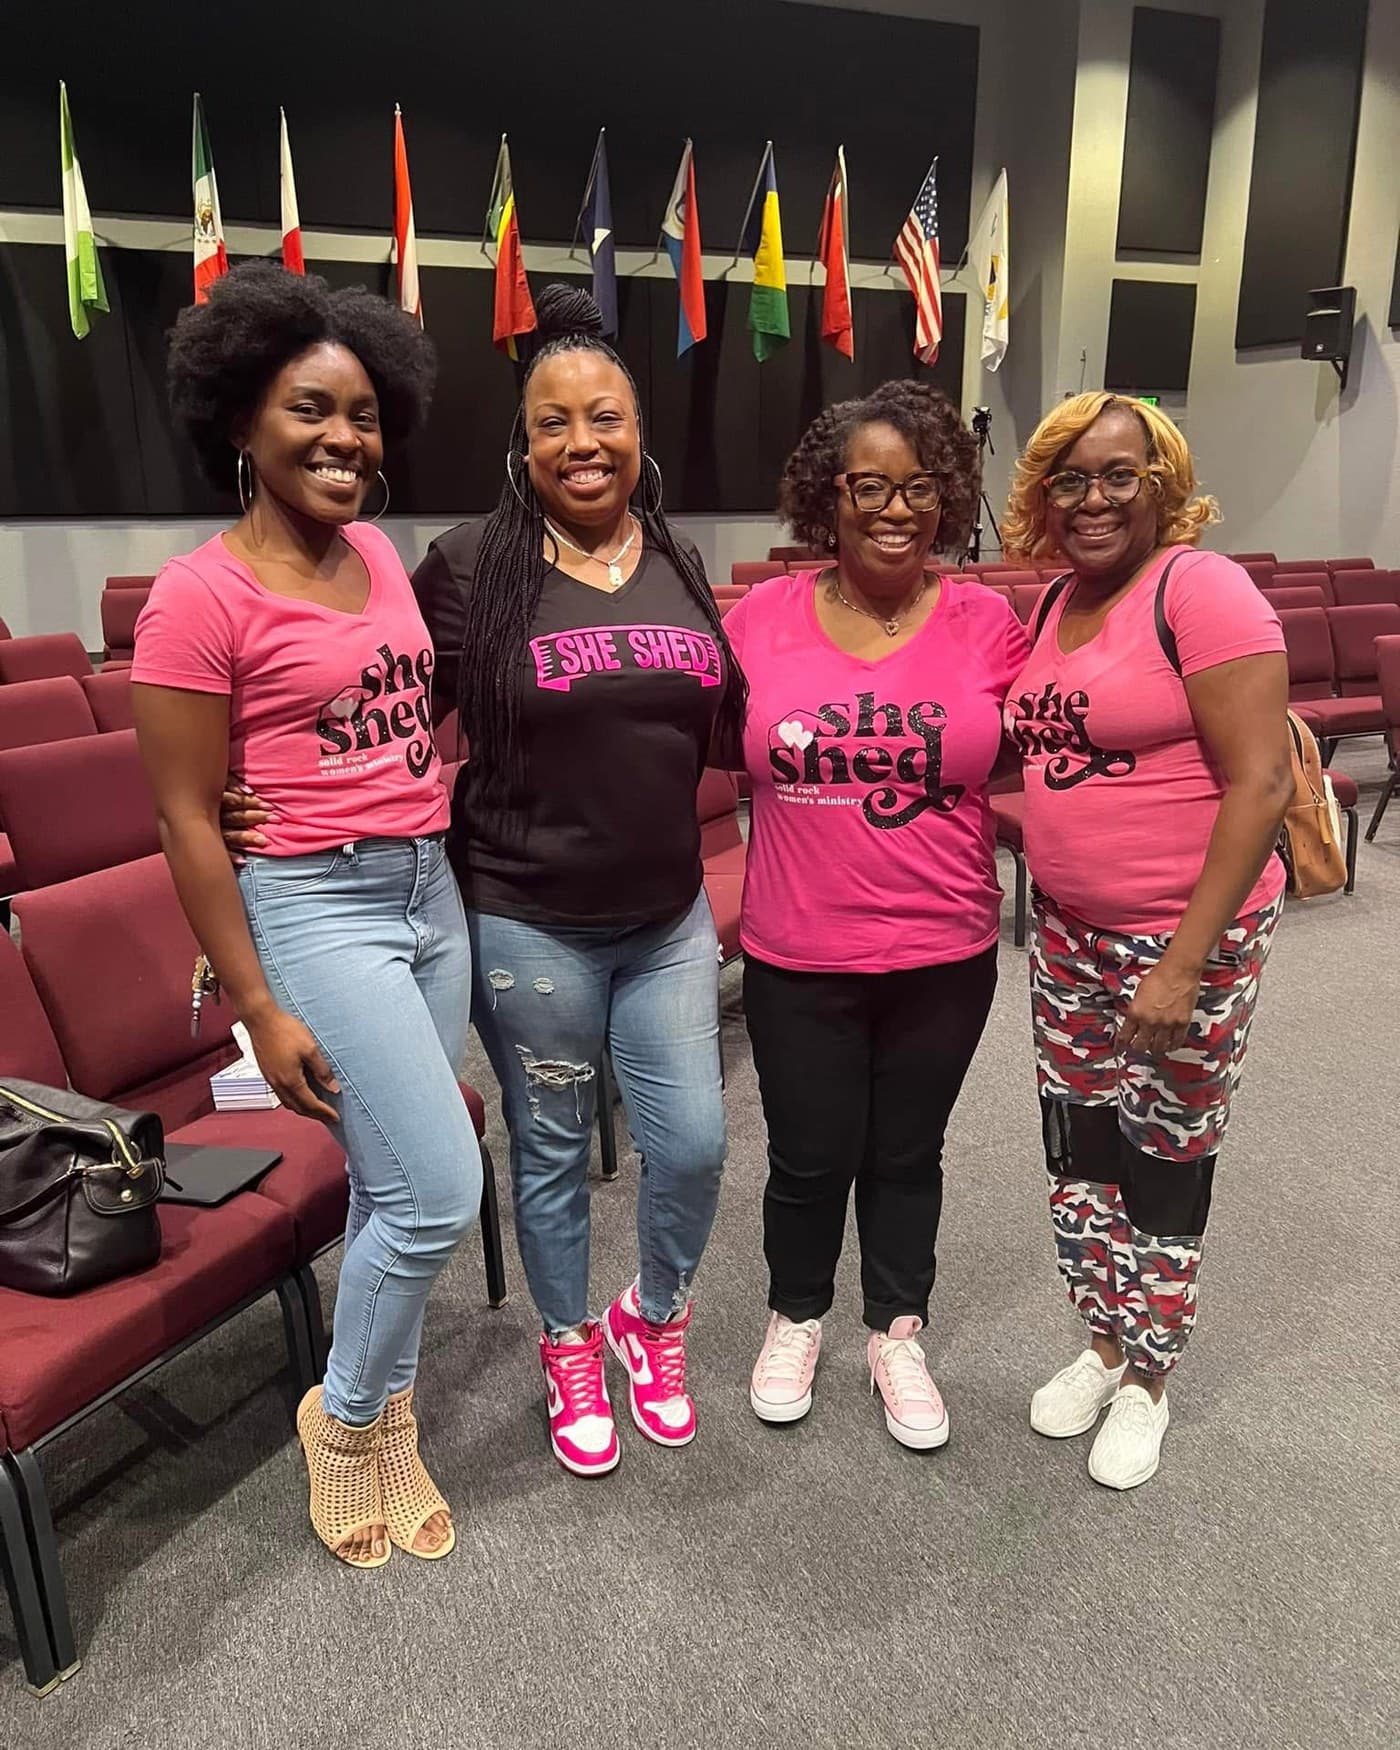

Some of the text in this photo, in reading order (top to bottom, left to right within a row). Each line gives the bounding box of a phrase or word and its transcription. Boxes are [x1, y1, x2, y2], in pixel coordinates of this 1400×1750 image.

[361, 643, 434, 703] she
[555, 630, 710, 674] SHE SHED
[813, 691, 948, 738] she
[1015, 681, 1090, 722] she
[316, 692, 438, 779] shed
[1012, 716, 1136, 791] hed
[768, 733, 967, 830] shed
[797, 785, 820, 795] rock
[817, 795, 863, 808] ministry
